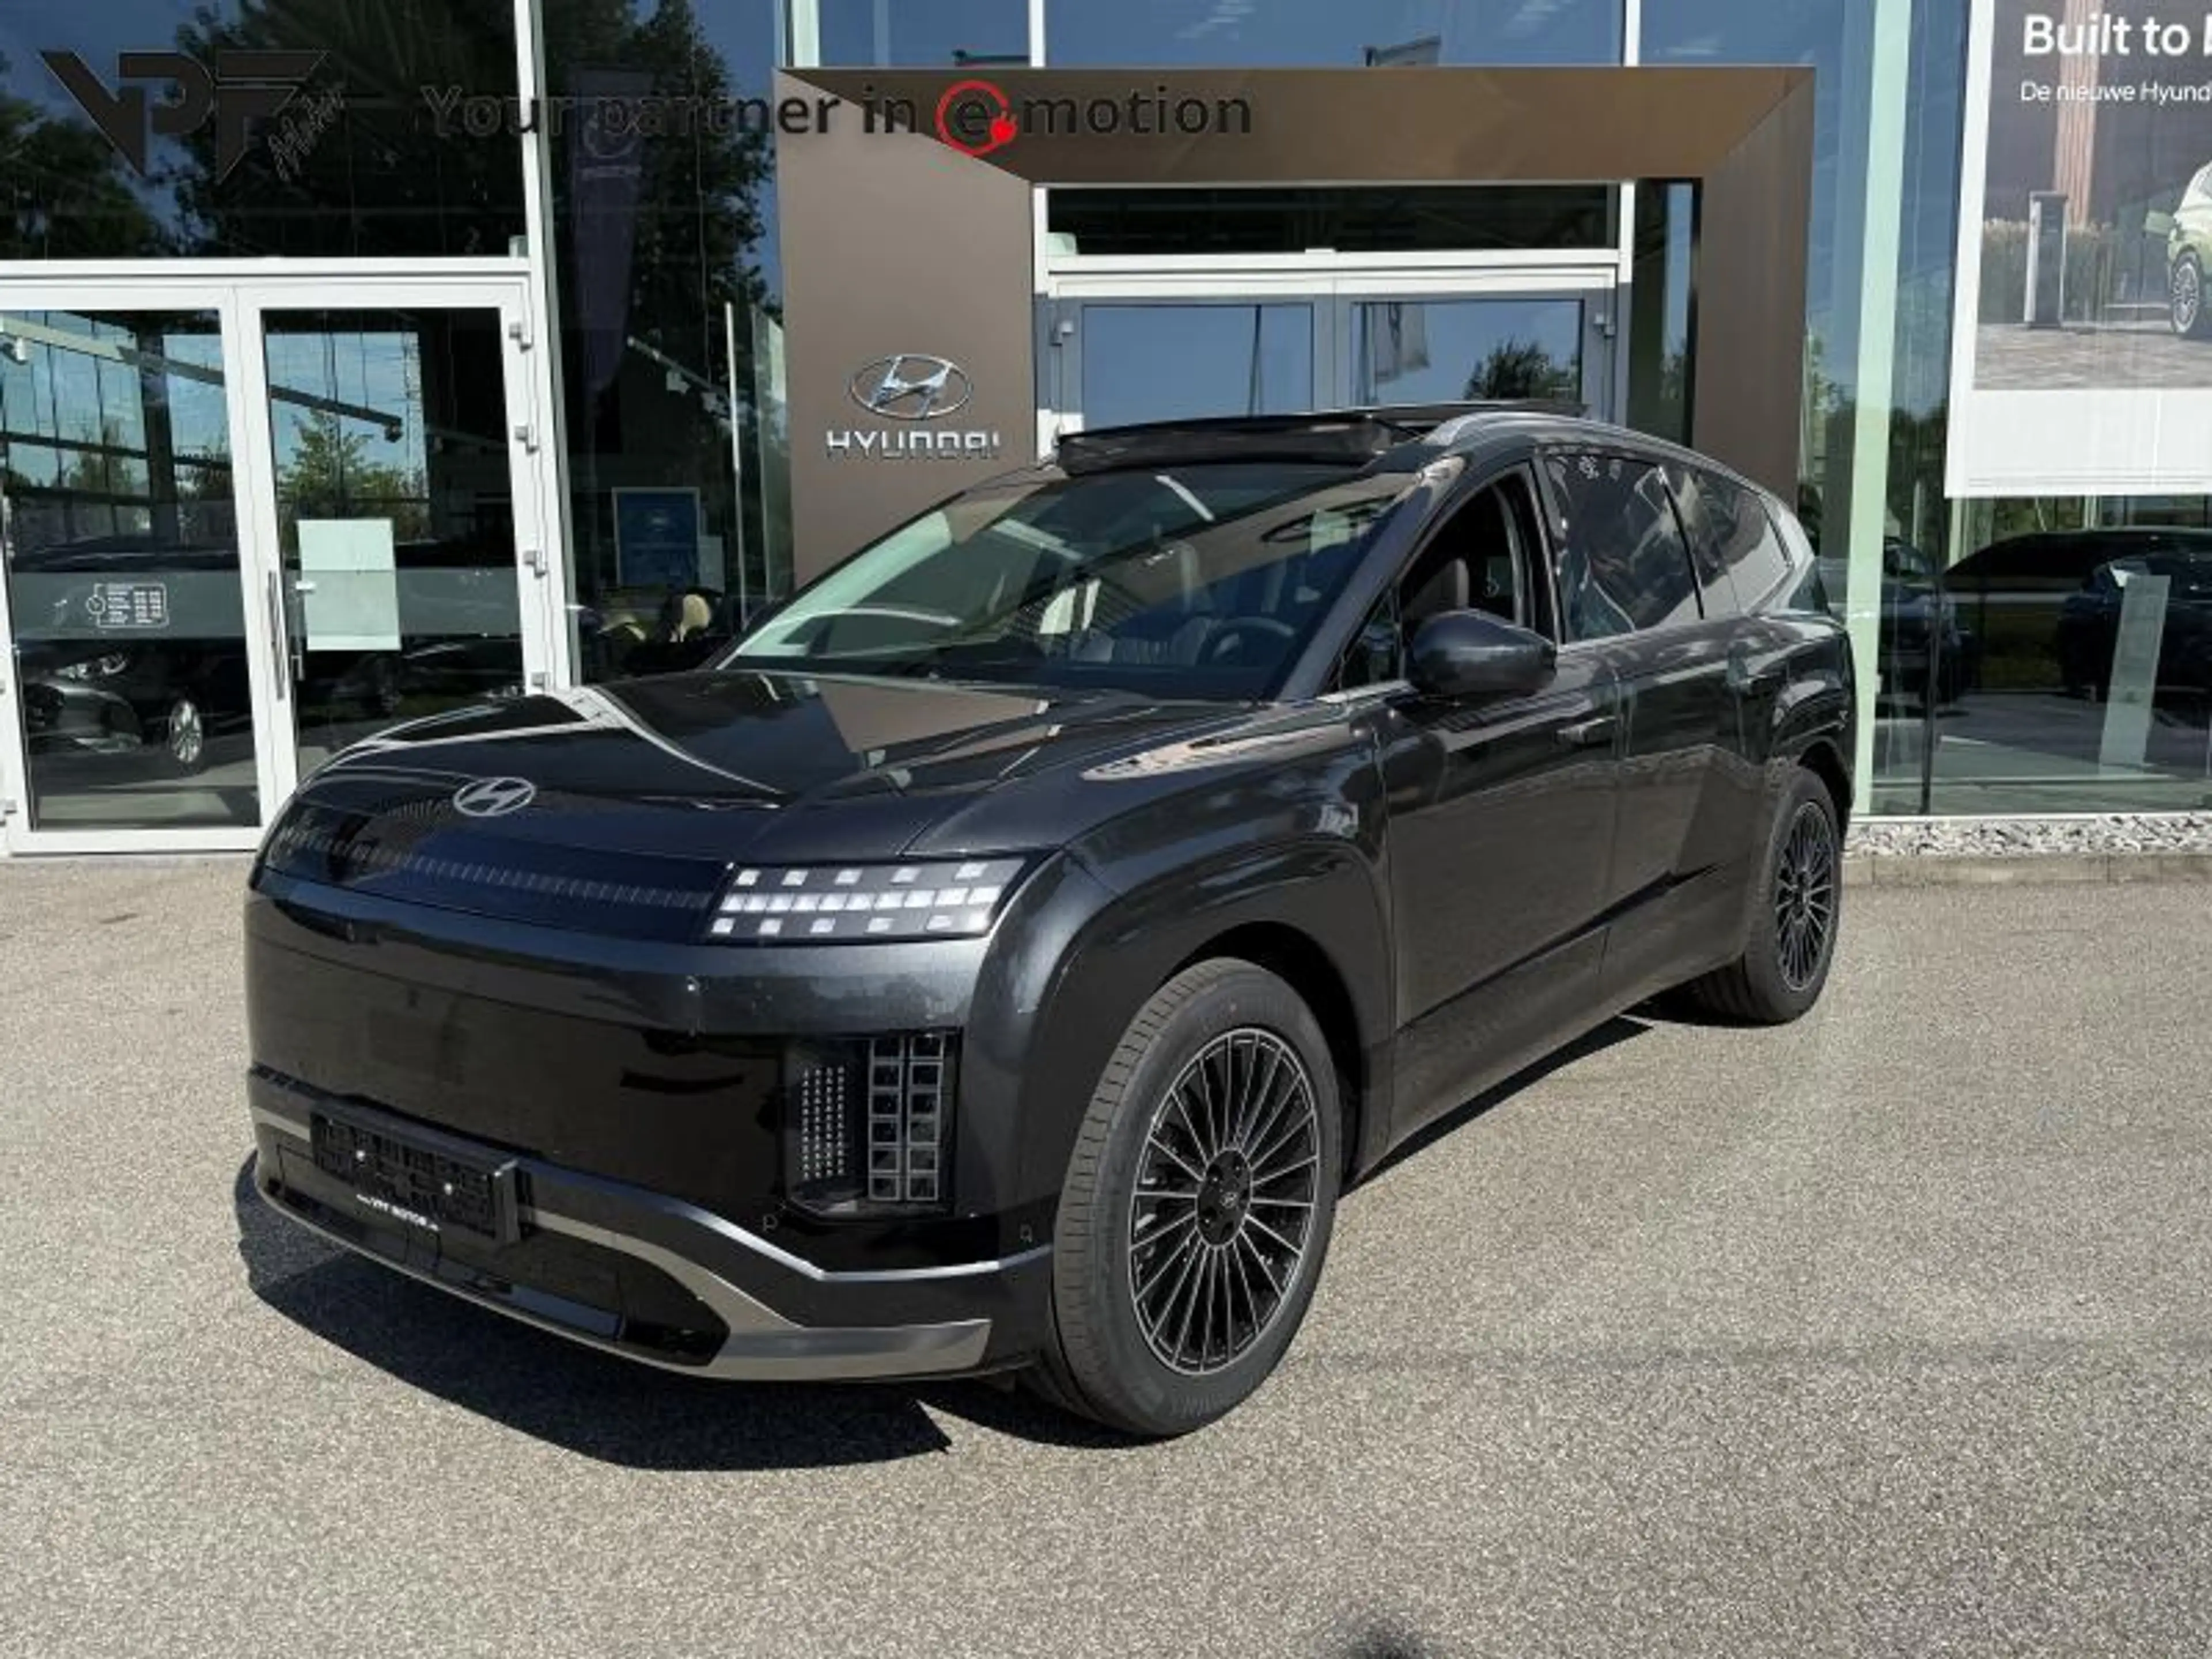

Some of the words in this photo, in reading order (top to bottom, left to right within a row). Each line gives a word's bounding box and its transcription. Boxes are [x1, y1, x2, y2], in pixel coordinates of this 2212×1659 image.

[2023, 13, 2131, 56] Built
[2142, 16, 2191, 56] to
[2020, 81, 2051, 101] De
[2056, 81, 2136, 101] nieuwe
[825, 430, 1001, 460] HYUNDAI
